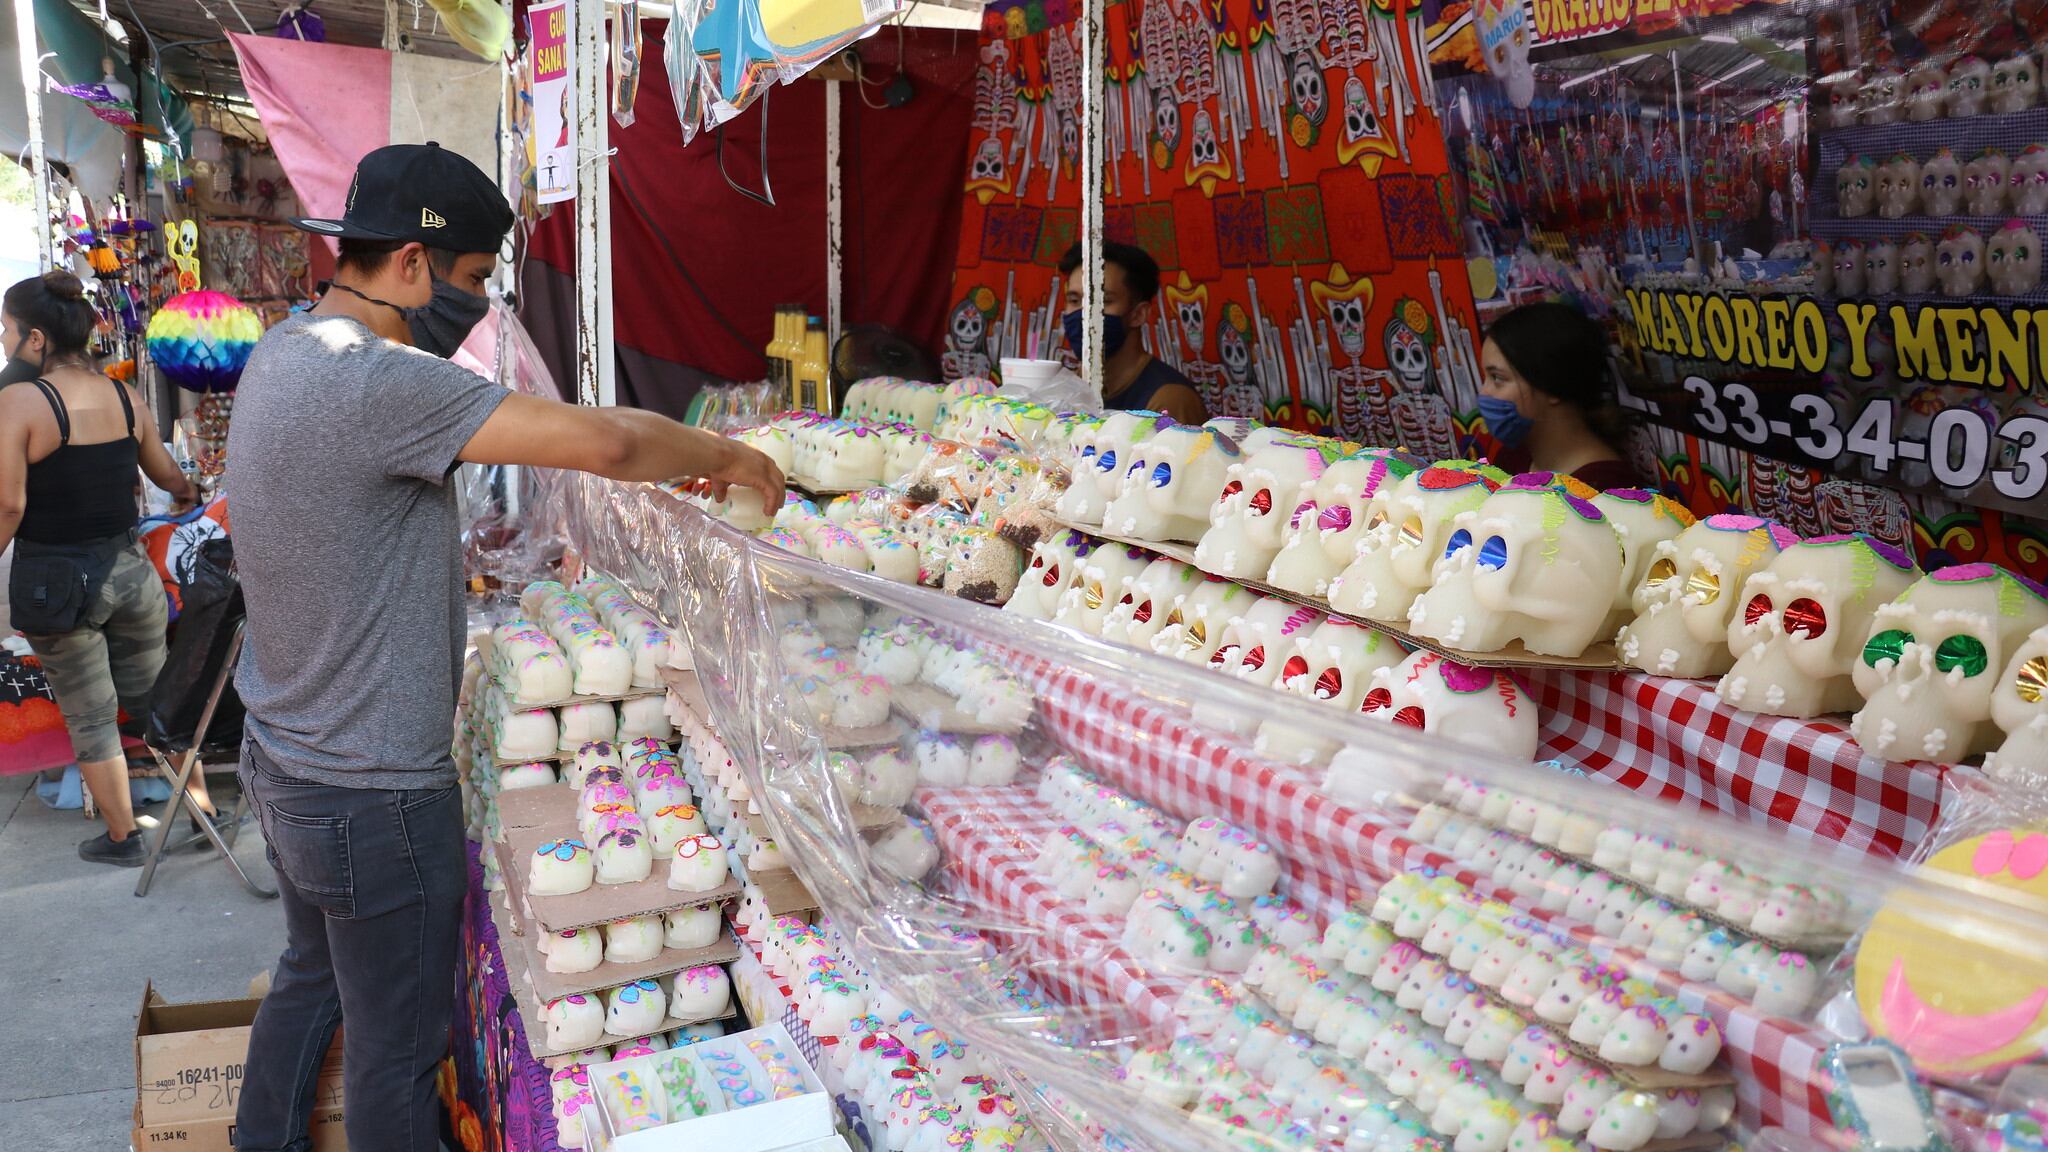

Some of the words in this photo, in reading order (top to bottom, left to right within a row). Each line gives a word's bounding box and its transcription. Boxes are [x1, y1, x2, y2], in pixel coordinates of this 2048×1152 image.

[1485, 10, 1523, 48] MARIO
[537, 44, 562, 75] SANA
[1626, 289, 1829, 374] MAYOREO
[1837, 303, 1877, 378] Y
[1683, 376, 2048, 499] 33-34-03
[176, 1064, 246, 1085] 16241-00
[150, 1131, 174, 1142] 11.34
[176, 1130, 187, 1141] Kg
